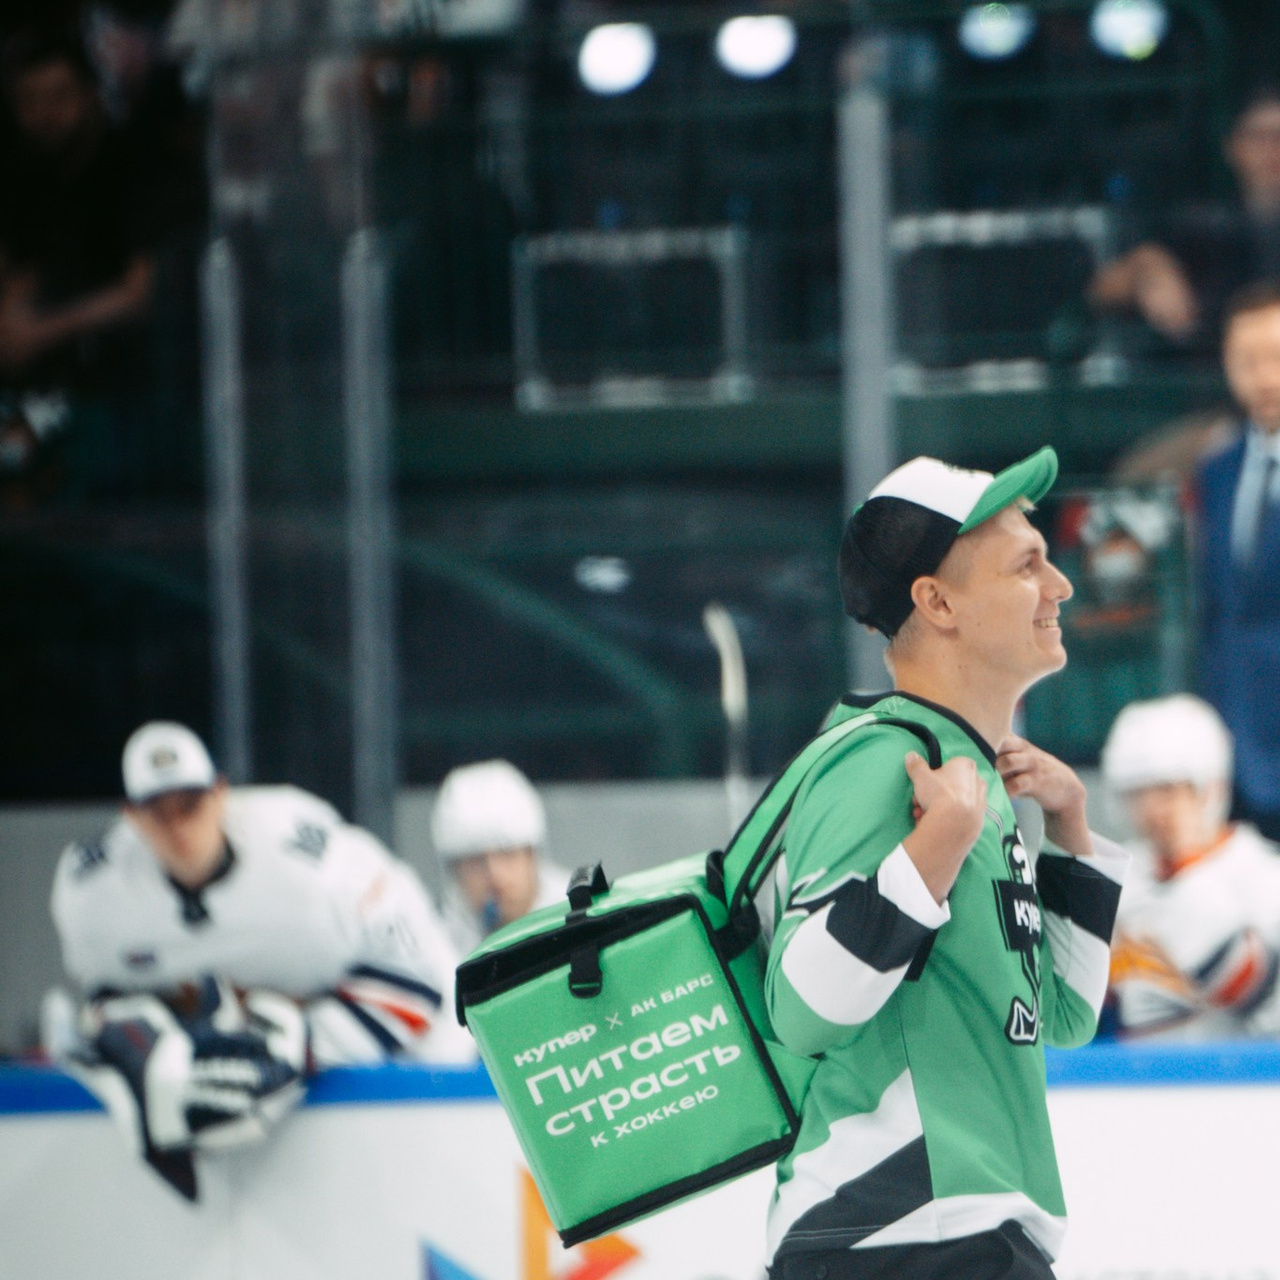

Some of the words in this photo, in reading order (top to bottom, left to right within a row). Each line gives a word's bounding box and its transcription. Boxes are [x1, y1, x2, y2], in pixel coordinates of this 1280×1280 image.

[514, 1024, 596, 1067] купер
[631, 997, 655, 1017] АК
[662, 974, 713, 1003] БАРС
[525, 1005, 728, 1106] Питаем
[546, 1045, 741, 1135] страсть
[615, 1085, 718, 1137] хоккею
